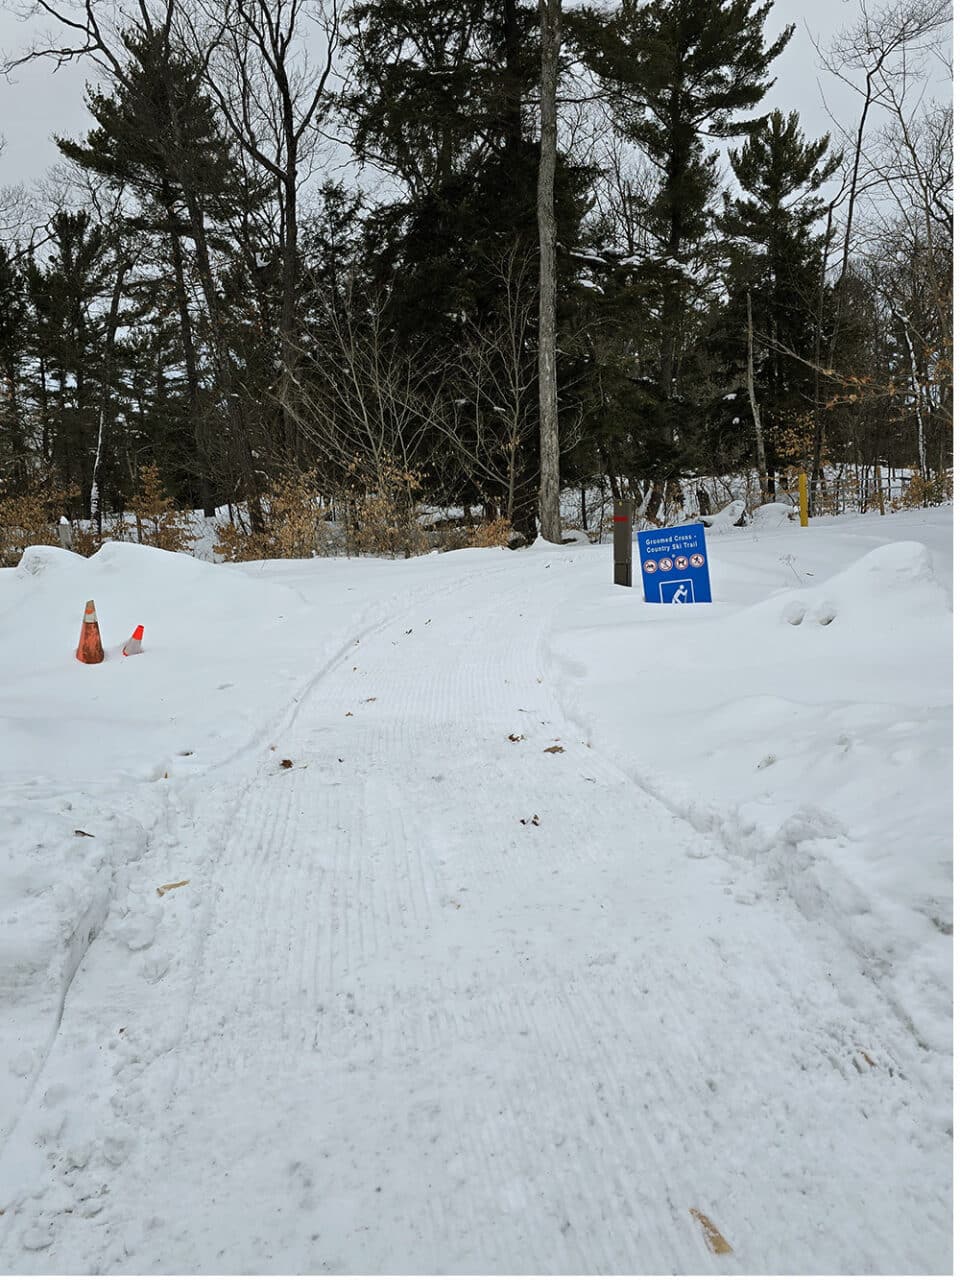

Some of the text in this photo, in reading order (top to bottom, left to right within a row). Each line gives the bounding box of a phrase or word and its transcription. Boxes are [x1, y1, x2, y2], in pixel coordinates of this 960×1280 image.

[645, 536, 673, 546] Groomed
[673, 534, 692, 542] Cross
[646, 545, 670, 554] Country
[683, 540, 698, 549] Trail
